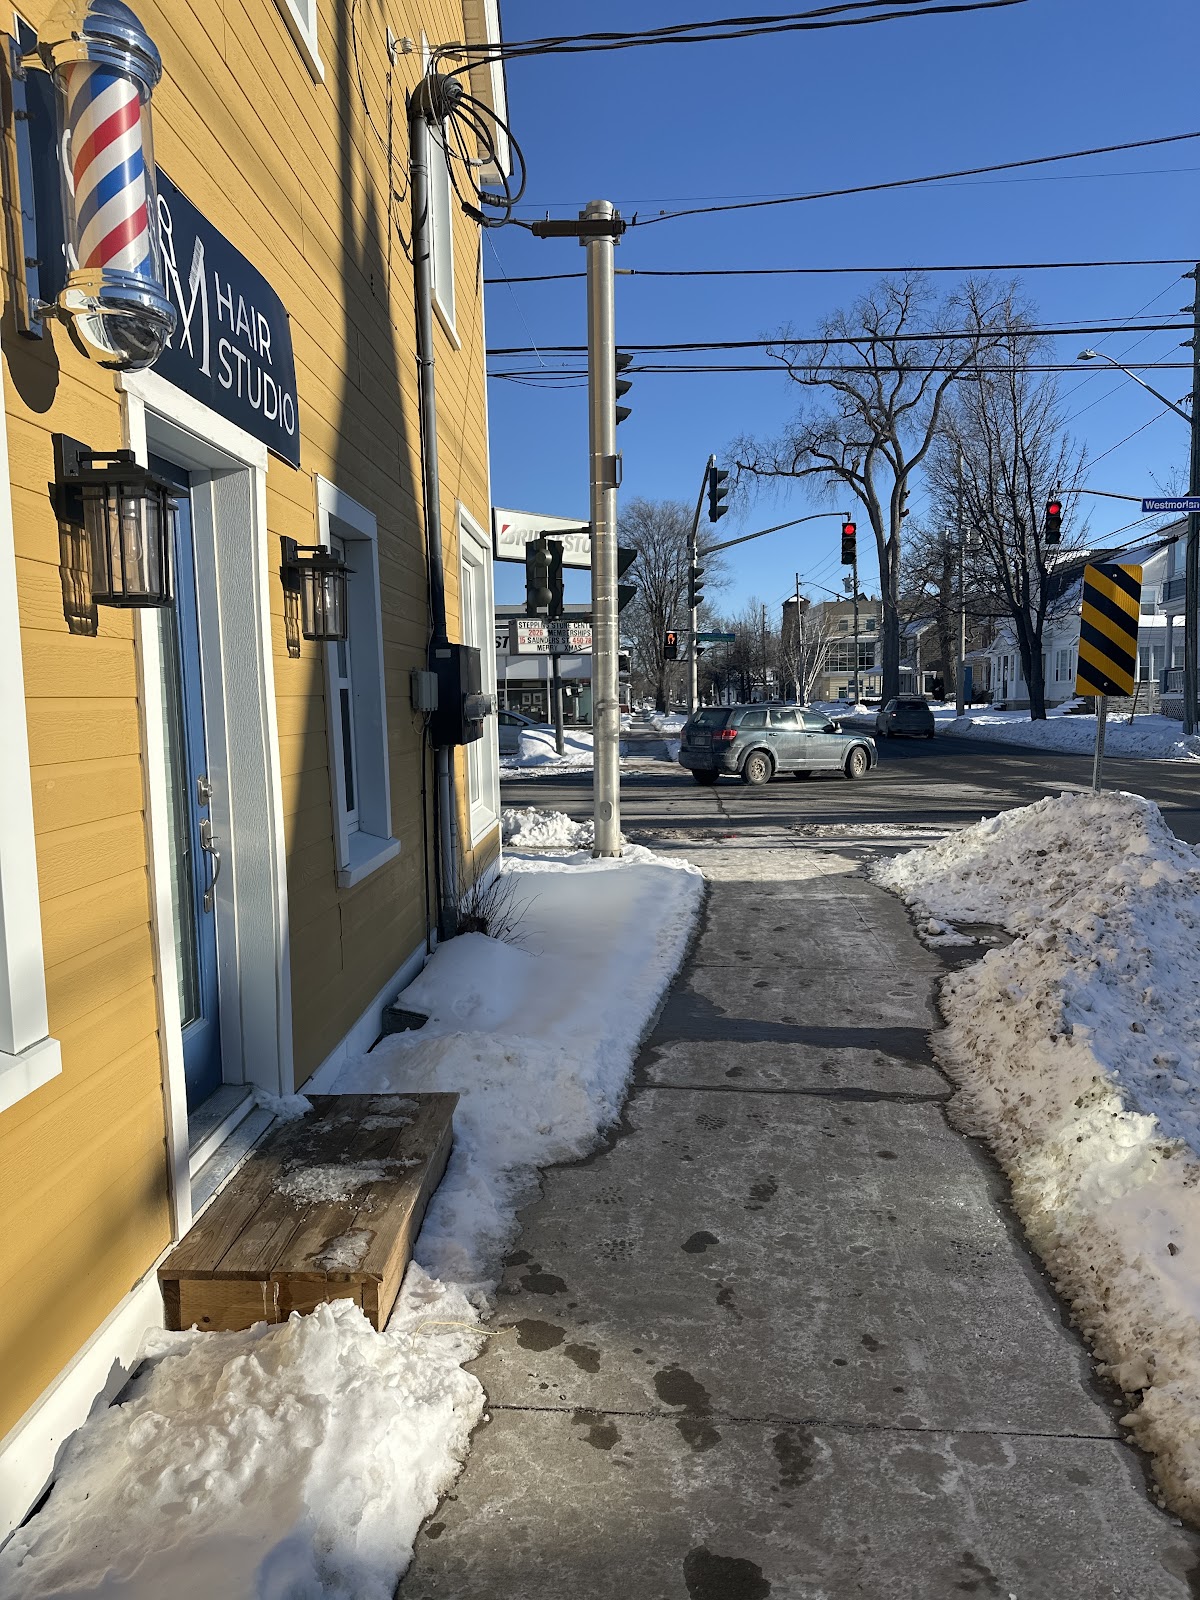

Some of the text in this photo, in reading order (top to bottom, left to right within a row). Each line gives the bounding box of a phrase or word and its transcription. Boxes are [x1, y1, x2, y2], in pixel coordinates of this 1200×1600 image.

[214, 271, 273, 366] HAIR
[217, 337, 295, 436] STUDIO
[1145, 500, 1200, 509] Westmorlan
[547, 629, 592, 637] MEMBERSHIPS
[519, 636, 526, 644] 15
